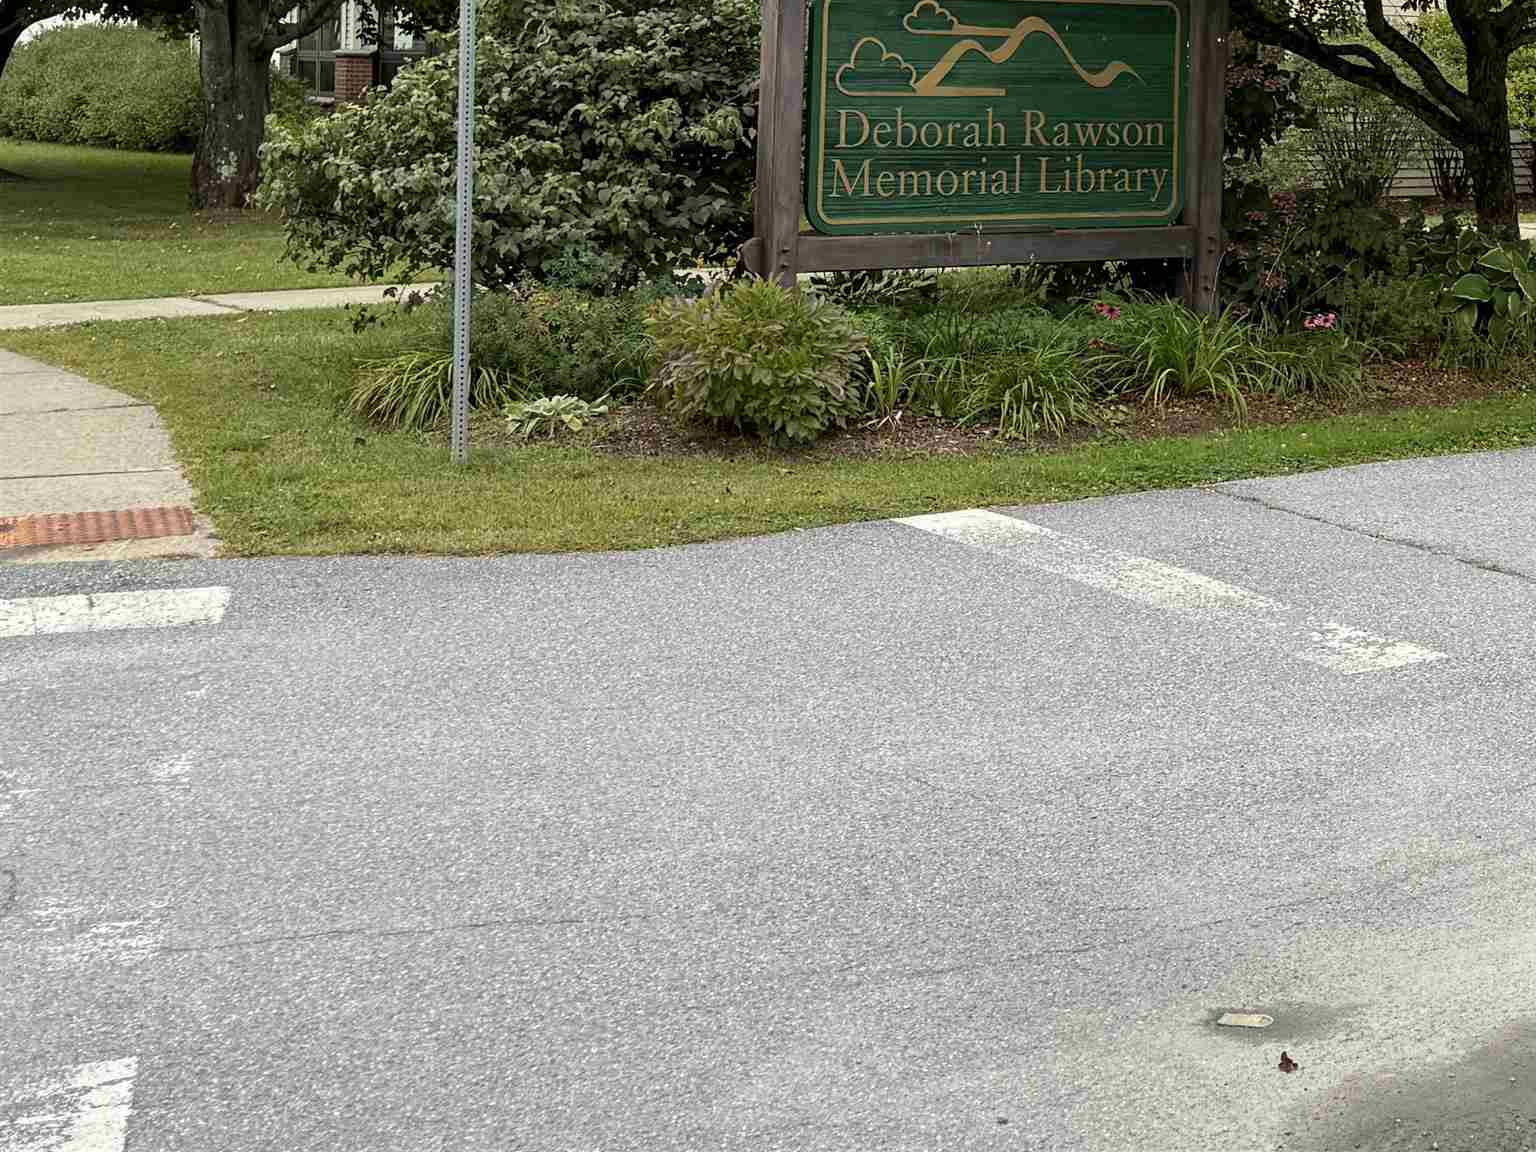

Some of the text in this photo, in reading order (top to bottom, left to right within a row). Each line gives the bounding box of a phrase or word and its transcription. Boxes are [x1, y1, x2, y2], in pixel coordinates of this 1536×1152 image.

[836, 108, 1166, 149] Deborah Rawson
[830, 154, 1169, 203] Memorial Library
